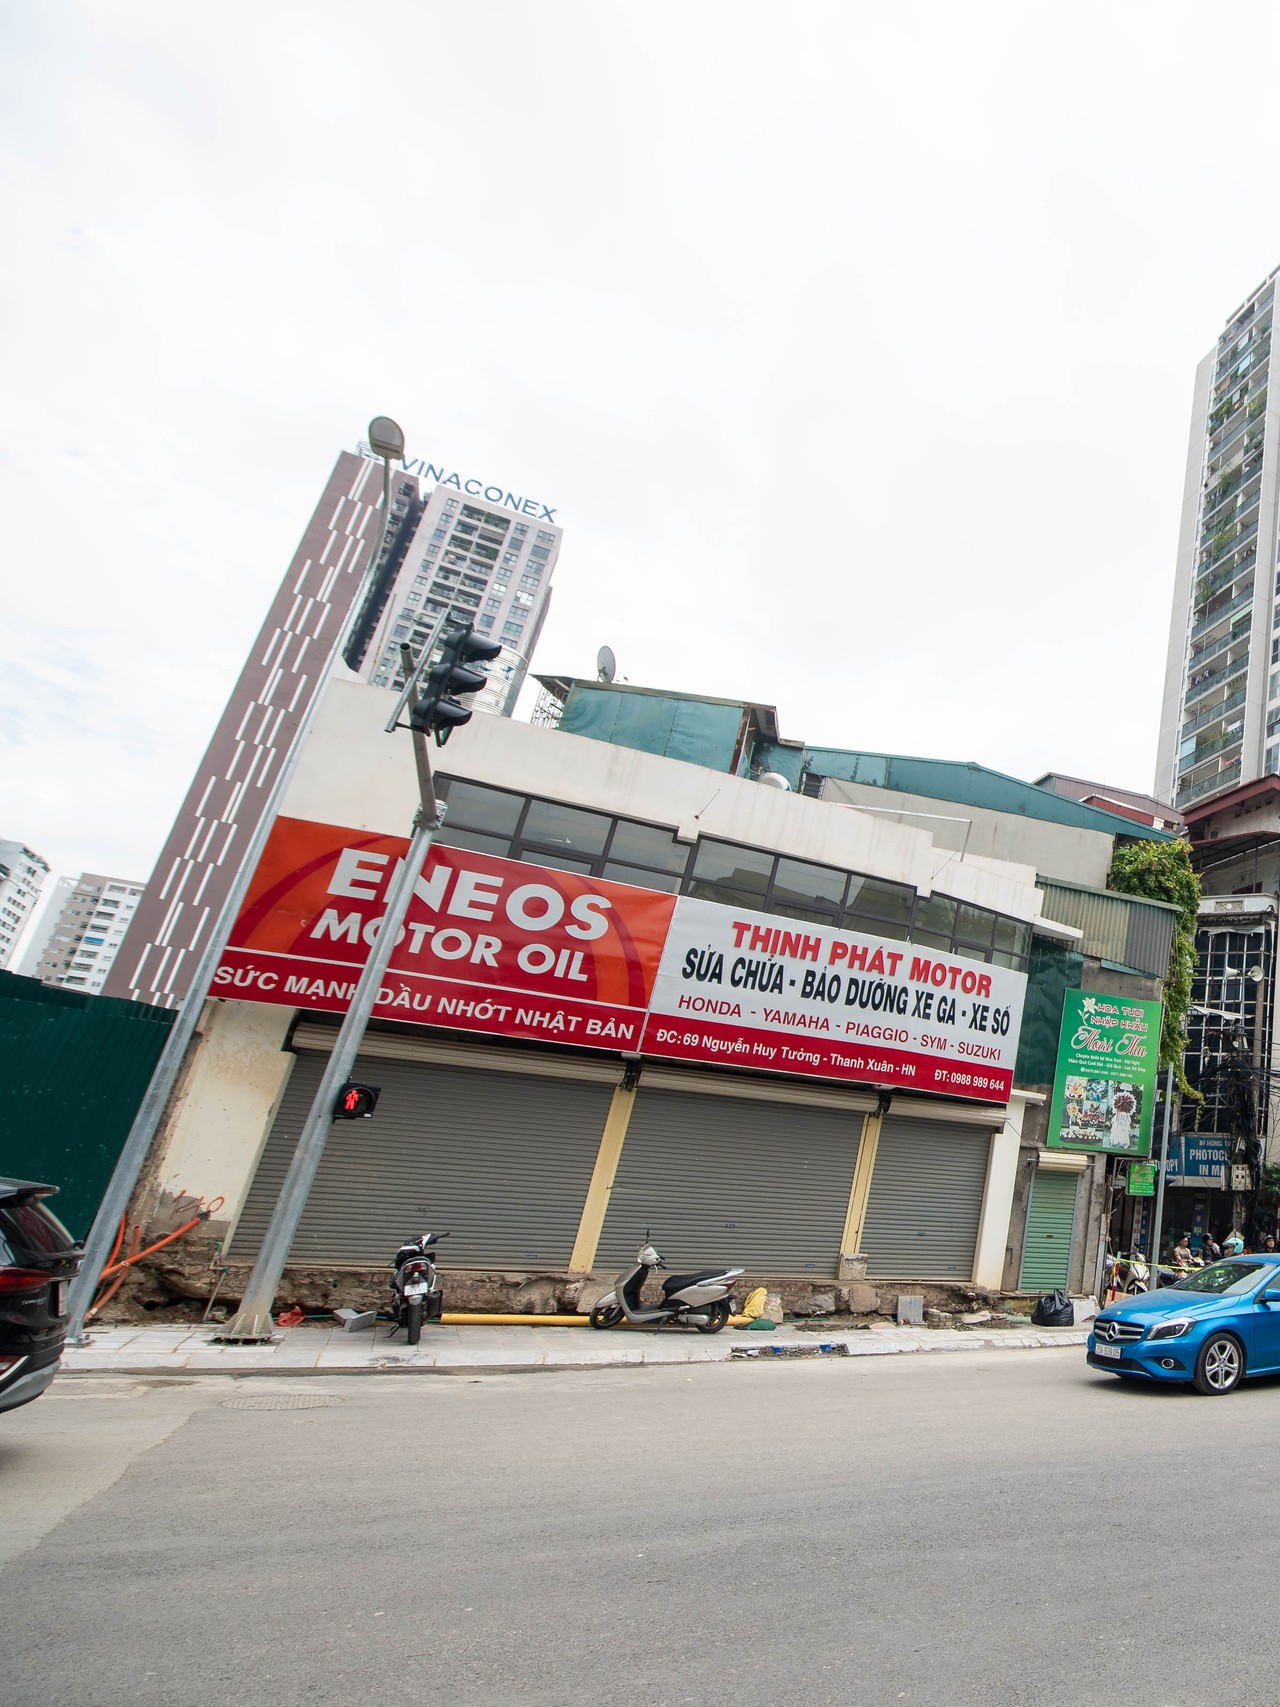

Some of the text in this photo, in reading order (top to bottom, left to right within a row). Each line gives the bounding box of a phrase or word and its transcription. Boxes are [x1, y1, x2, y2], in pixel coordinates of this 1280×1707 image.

[401, 453, 558, 524] VINACONEX
[326, 847, 612, 941] ENEOS
[310, 908, 589, 982] MOTOR OIL
[732, 921, 992, 998] THỊNH PHÁT MOTOR
[213, 965, 279, 990] SỨC
[375, 983, 432, 1011] DẦU
[437, 996, 511, 1023] NHỚT
[514, 1008, 582, 1036] NHẬT
[586, 1018, 635, 1041] BẢN
[682, 944, 1011, 1036] SỬA CHỮA BẢO DƯỠNG XE GA XE SỐ
[1090, 1015, 1148, 1032] NHẬP KHẨU
[1097, 1003, 1119, 1014] HOA
[678, 994, 1001, 1061] HONDA YAMAHA PIAGGIO SYM SUZUKI
[1115, 1033, 1147, 1057] Thu
[702, 1035, 750, 1054] Nguyễn
[752, 1042, 777, 1059] Huy
[781, 1046, 820, 1066] Tưởng
[830, 1053, 864, 1070] Thanh
[866, 1058, 893, 1073] Xuân
[901, 1063, 916, 1076] HN
[951, 1072, 971, 1086] 0988
[973, 1076, 989, 1088] 989
[989, 1079, 1004, 1091] 644
[1199, 1164, 1208, 1176] IN
